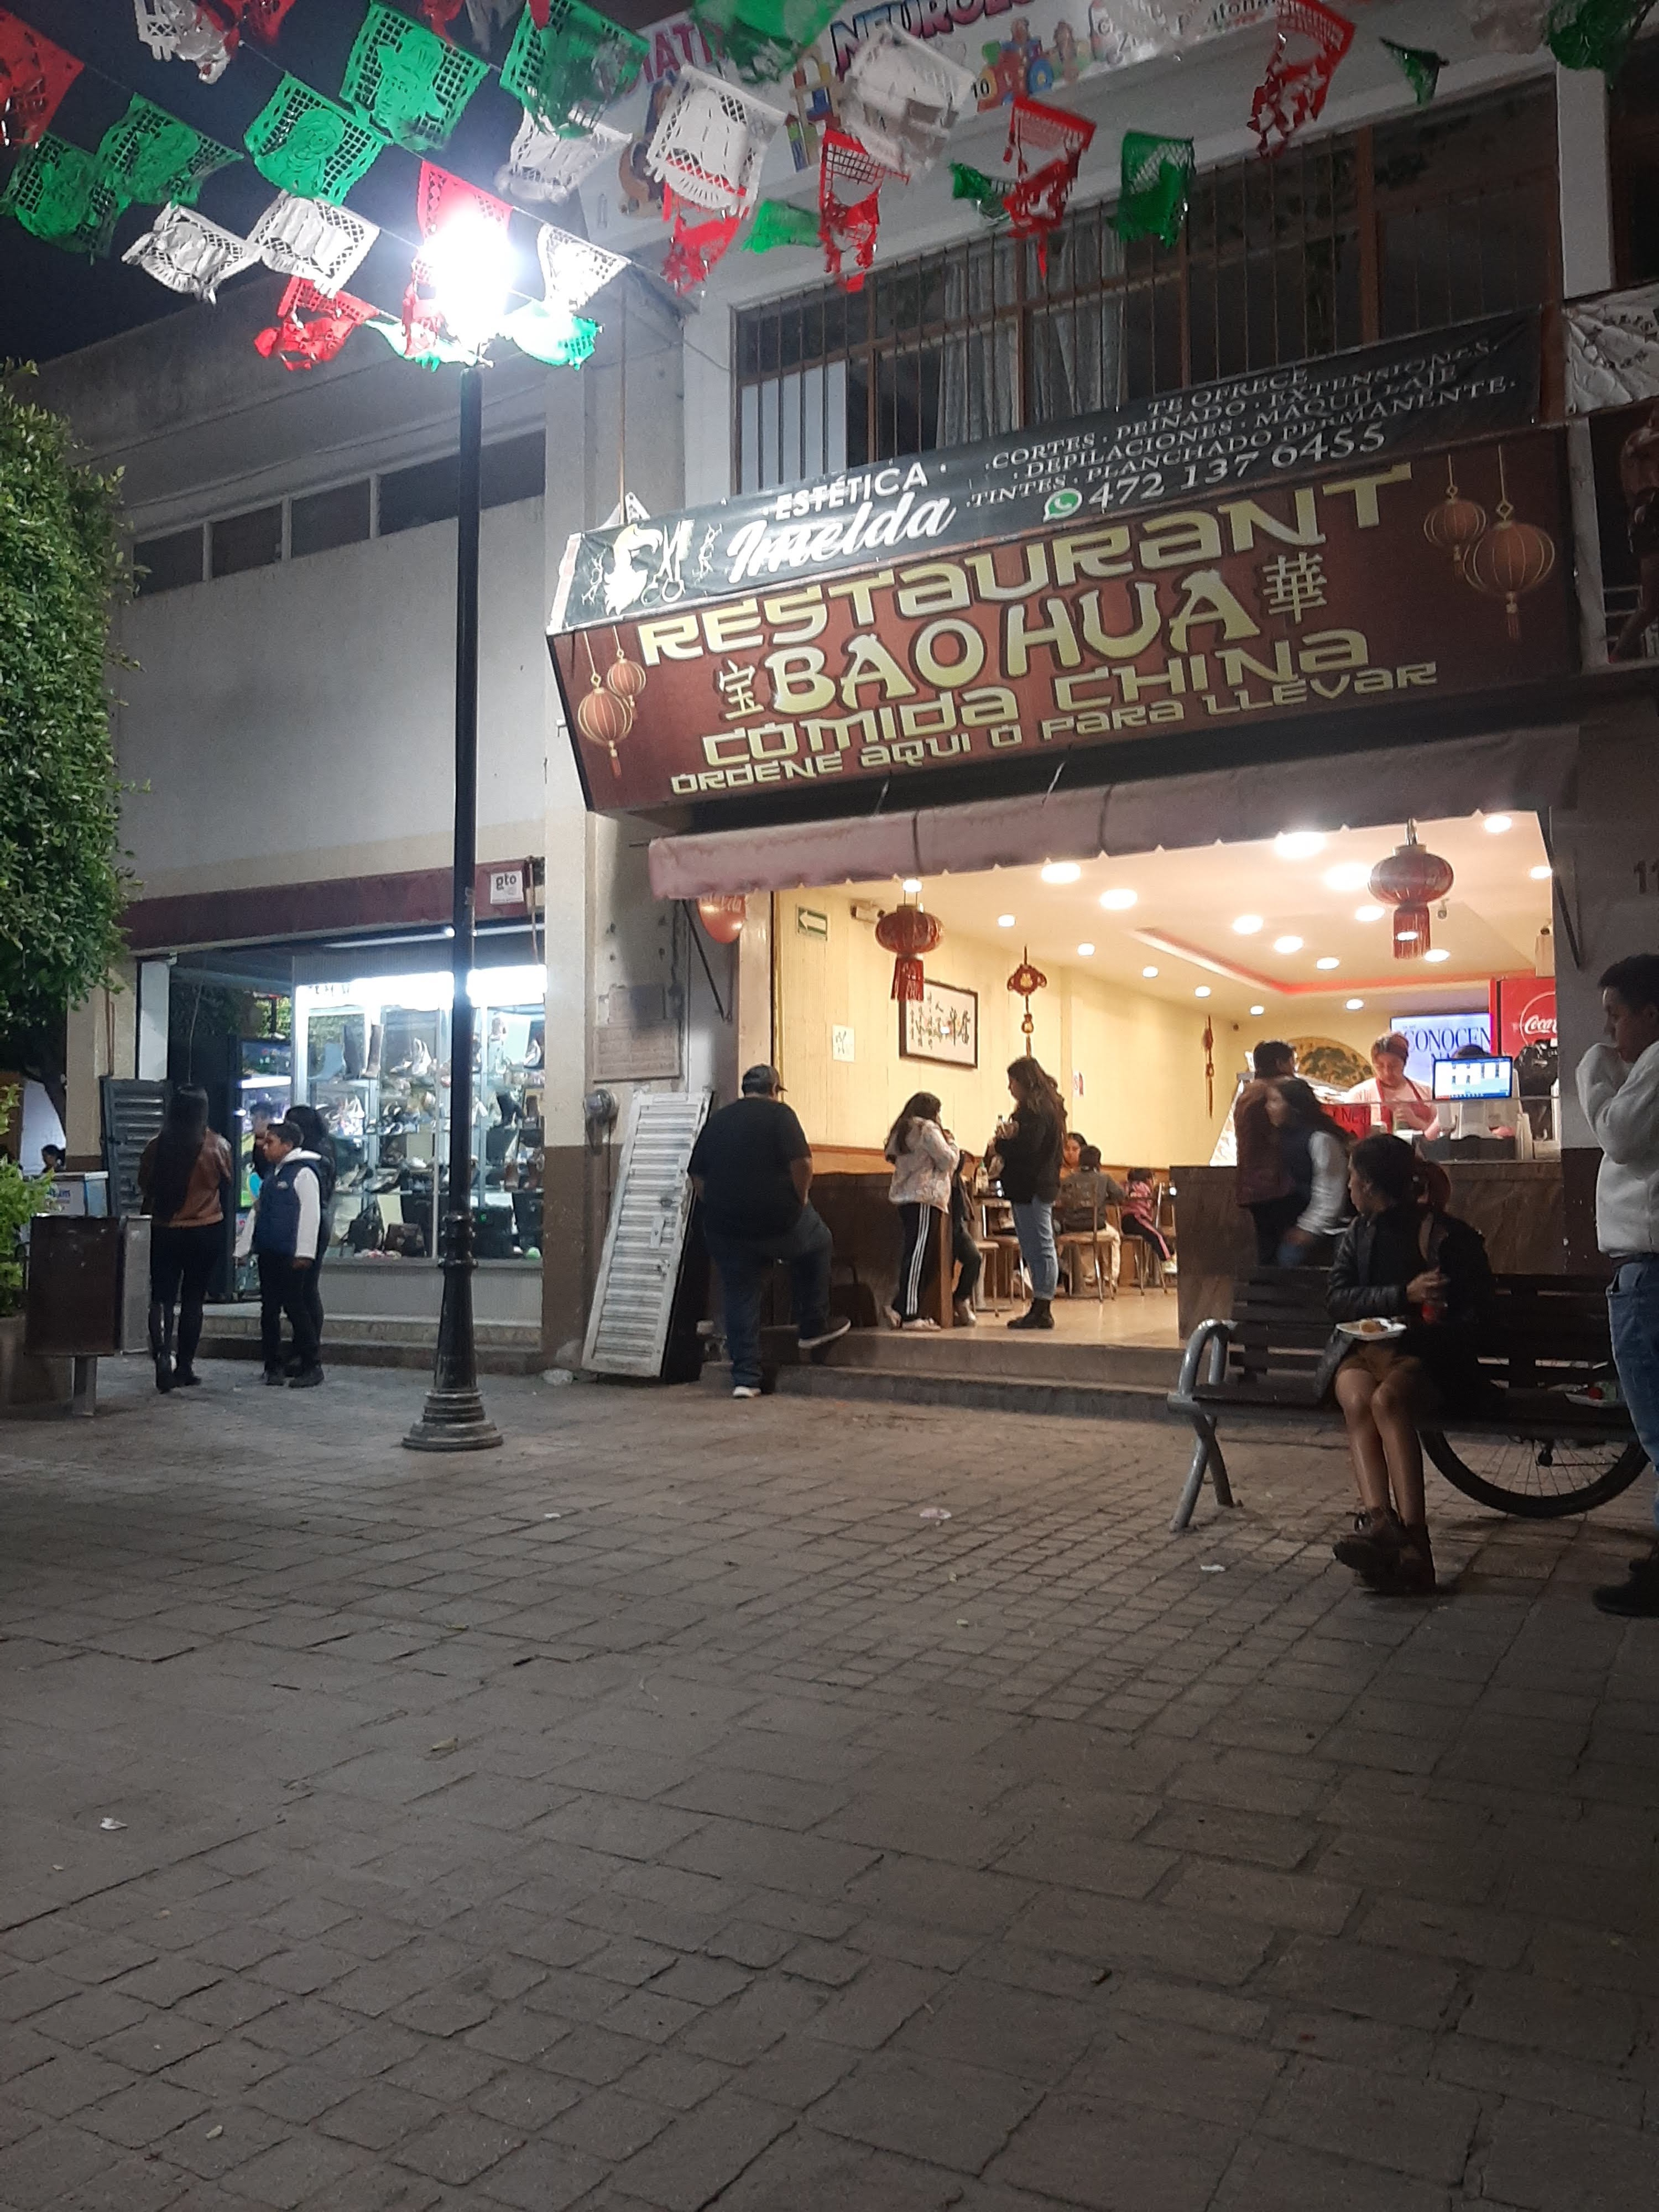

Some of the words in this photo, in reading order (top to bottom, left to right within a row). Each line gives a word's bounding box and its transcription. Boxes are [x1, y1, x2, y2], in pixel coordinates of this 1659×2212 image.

[1147, 395, 1183, 416] TE
[1191, 367, 1308, 406] OFRECE
[971, 474, 1066, 508] TINTES
[1087, 430, 1271, 483] PLANCHADO
[993, 432, 1095, 469] CORTES
[1117, 401, 1246, 440] PEINADO
[1026, 420, 1233, 479] DEPILACIONES
[1088, 472, 1165, 509] 472
[1181, 450, 1259, 491] 137
[1271, 421, 1386, 469] 6455
[775, 461, 928, 520] ESTÉTICA
[1262, 552, 1328, 624] 華
[764, 568, 1261, 716] BAOHUA
[1054, 628, 1369, 713] CHINA
[718, 659, 765, 721] 宝
[670, 751, 843, 795] ORDENE
